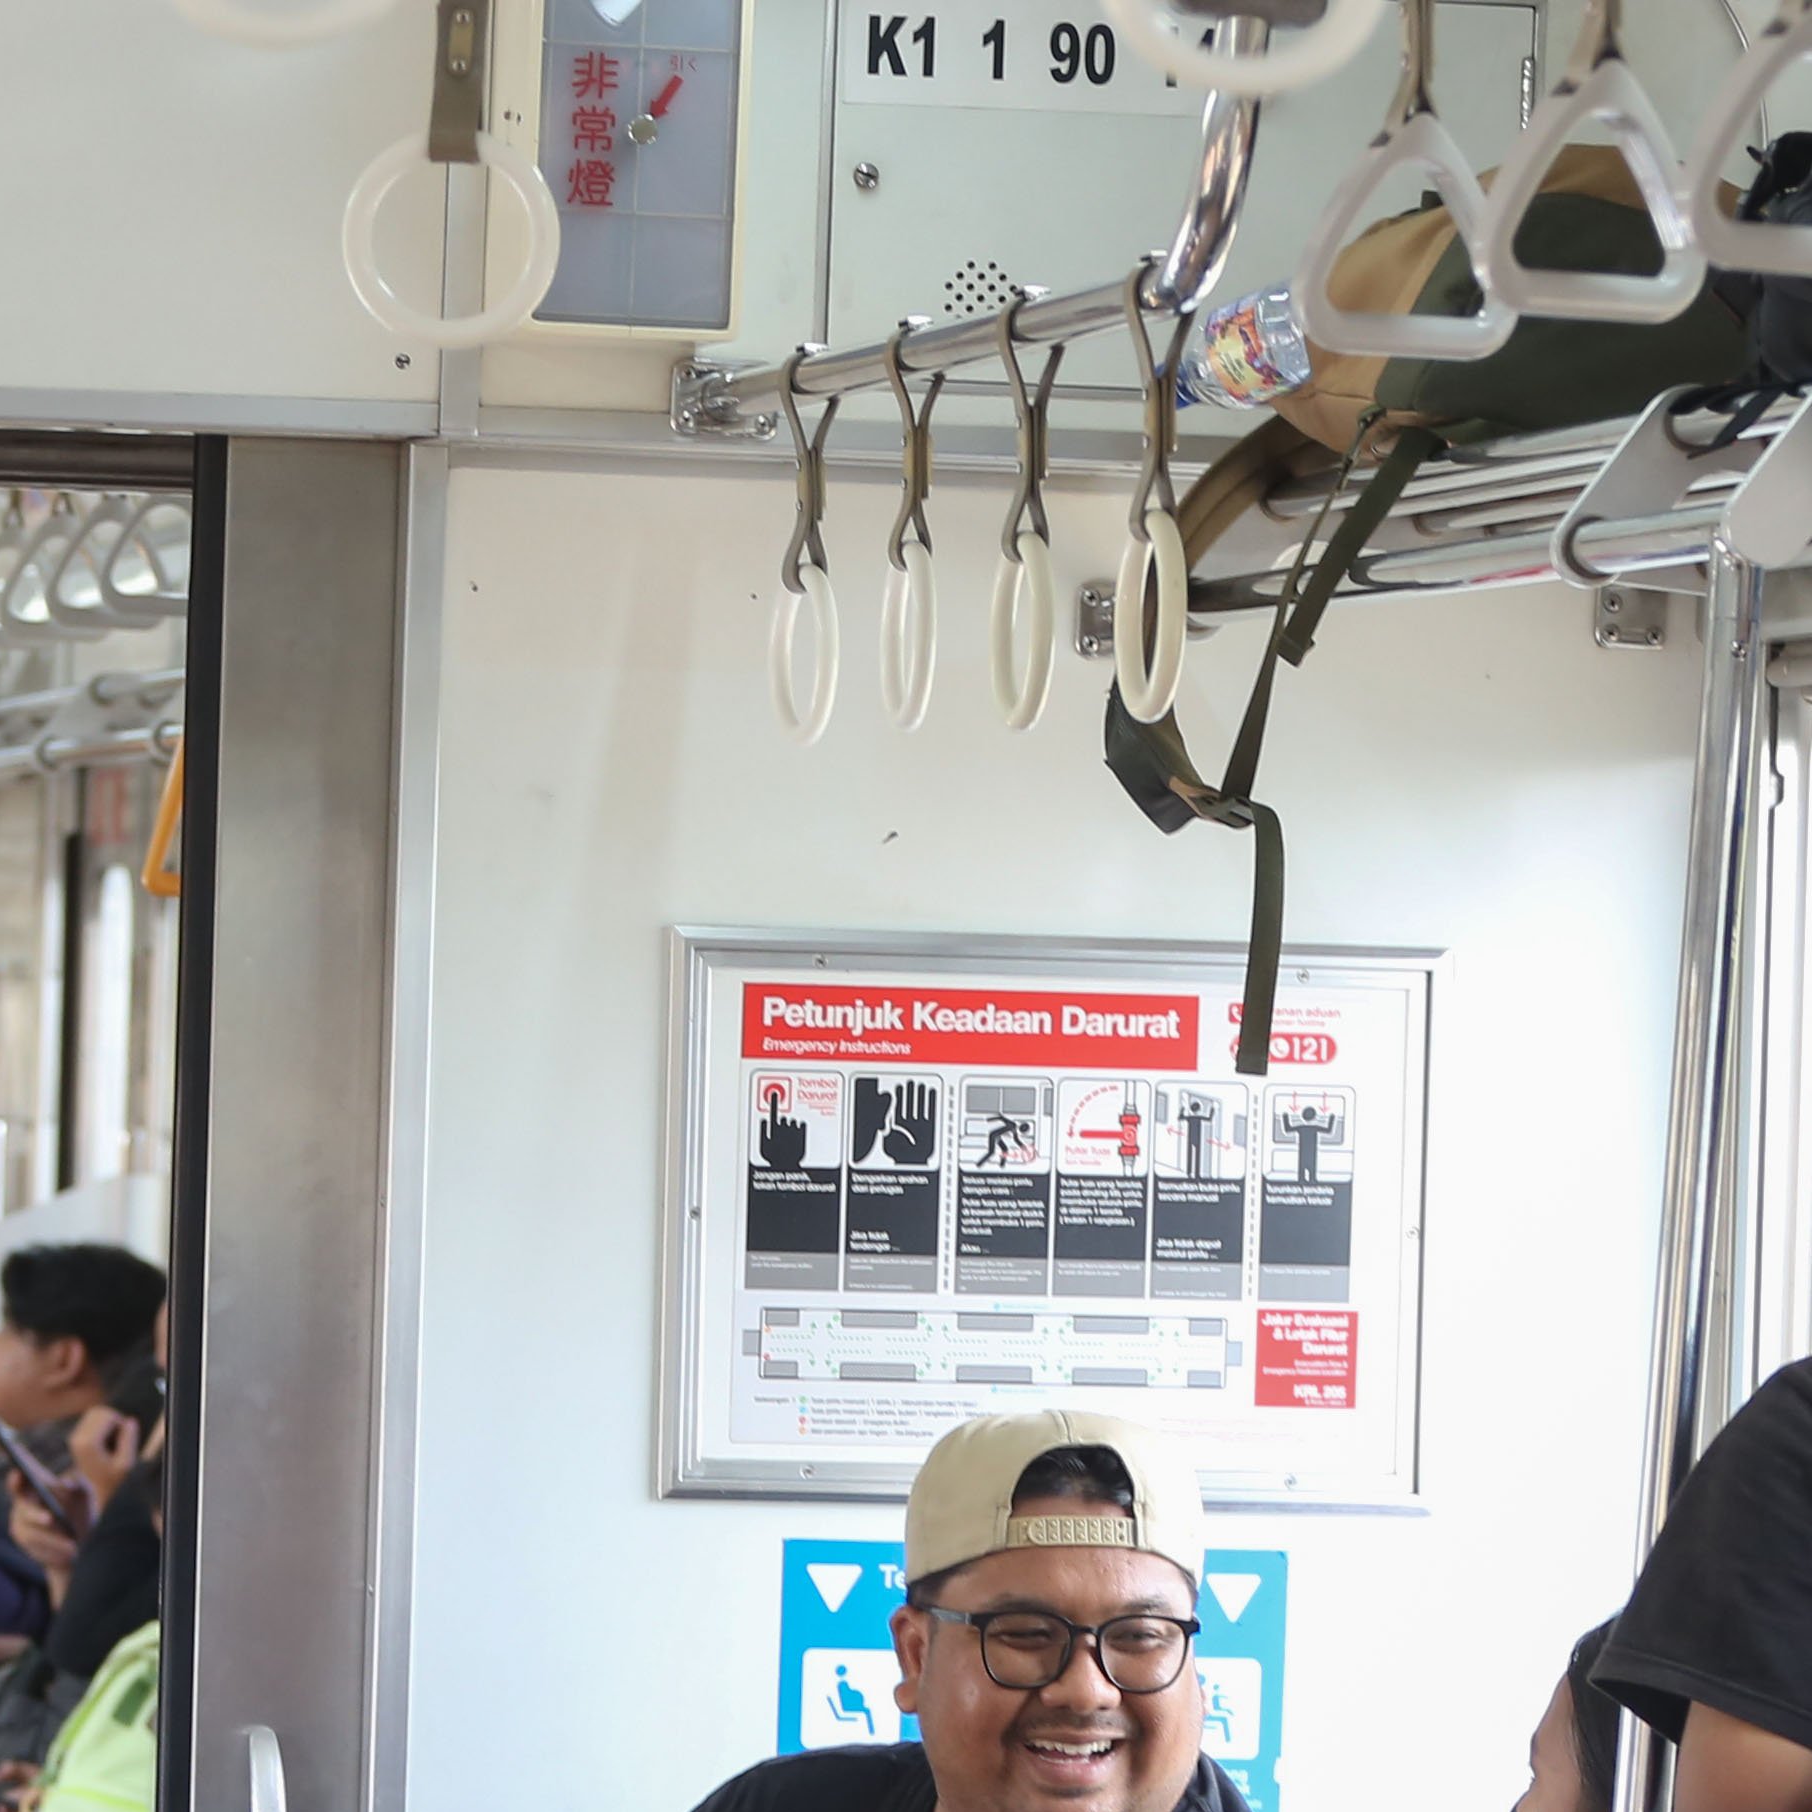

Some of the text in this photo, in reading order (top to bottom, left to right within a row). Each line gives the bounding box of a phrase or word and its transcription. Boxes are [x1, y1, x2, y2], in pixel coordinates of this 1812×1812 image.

[867, 14, 936, 77] K1
[982, 19, 1005, 80] 1
[1049, 21, 1116, 85] 90
[567, 51, 619, 207] 非常燈
[763, 996, 1180, 1040] Petunjuk Keadaan Darurat
[763, 1037, 911, 1056] Emergency Instructions
[1292, 1037, 1327, 1061] 121
